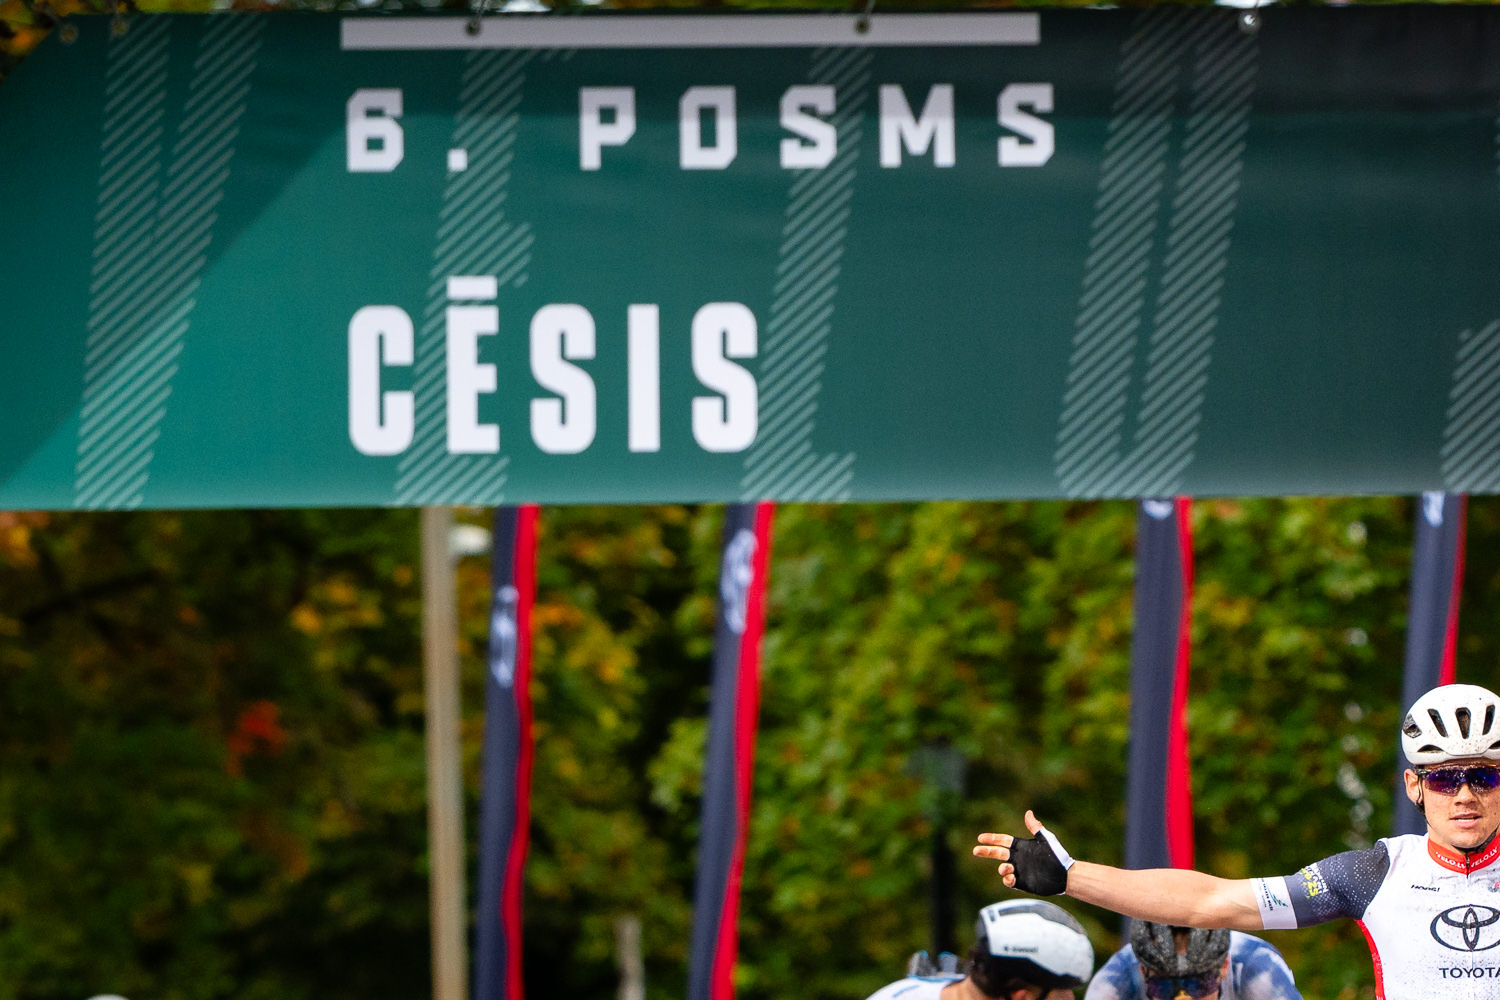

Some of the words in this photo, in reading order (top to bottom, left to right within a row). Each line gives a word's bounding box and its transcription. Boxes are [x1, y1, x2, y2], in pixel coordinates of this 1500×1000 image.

[347, 88, 468, 171] 6.
[579, 84, 1055, 170] POSMS
[347, 275, 759, 456] CĒSIS
